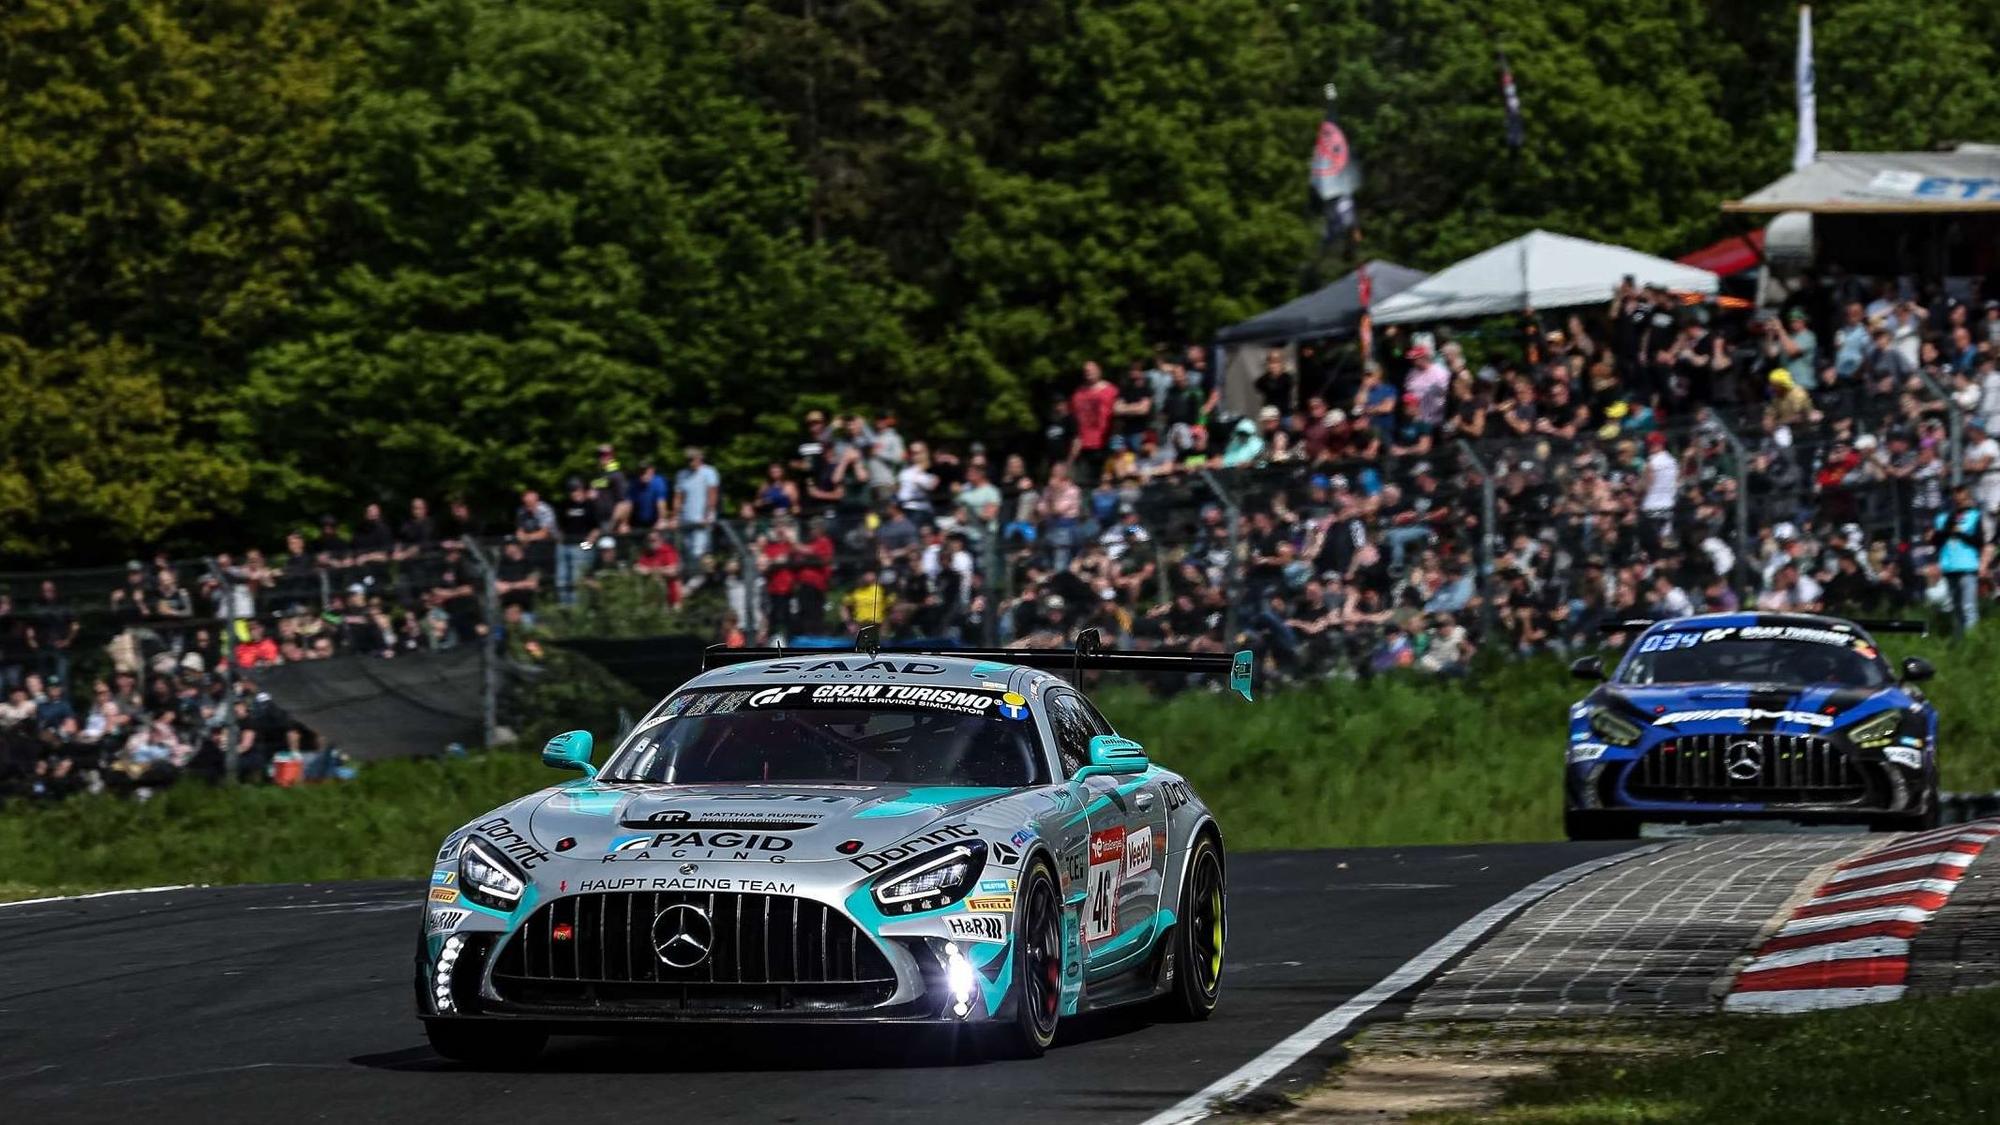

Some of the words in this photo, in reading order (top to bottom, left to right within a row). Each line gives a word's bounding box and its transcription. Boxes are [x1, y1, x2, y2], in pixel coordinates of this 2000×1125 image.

[1639, 631, 1702, 653] 034
[760, 660, 947, 675] SAAD
[798, 673, 897, 681] HOLDING
[812, 684, 885, 699] GRAN
[869, 698, 917, 708] DRIVING
[919, 700, 985, 715] SIMULATOR
[476, 817, 549, 870] Dorint
[651, 832, 793, 851] PAGID
[849, 823, 979, 874] Dorint
[602, 850, 787, 864] RACING
[1128, 834, 1151, 870] Veedol
[581, 879, 647, 891] HAUPT
[652, 878, 731, 890] RACING
[738, 879, 796, 894] TEAM
[969, 896, 1012, 910] PIRELLI
[1093, 870, 1111, 933] 46
[950, 917, 984, 935] H&R
